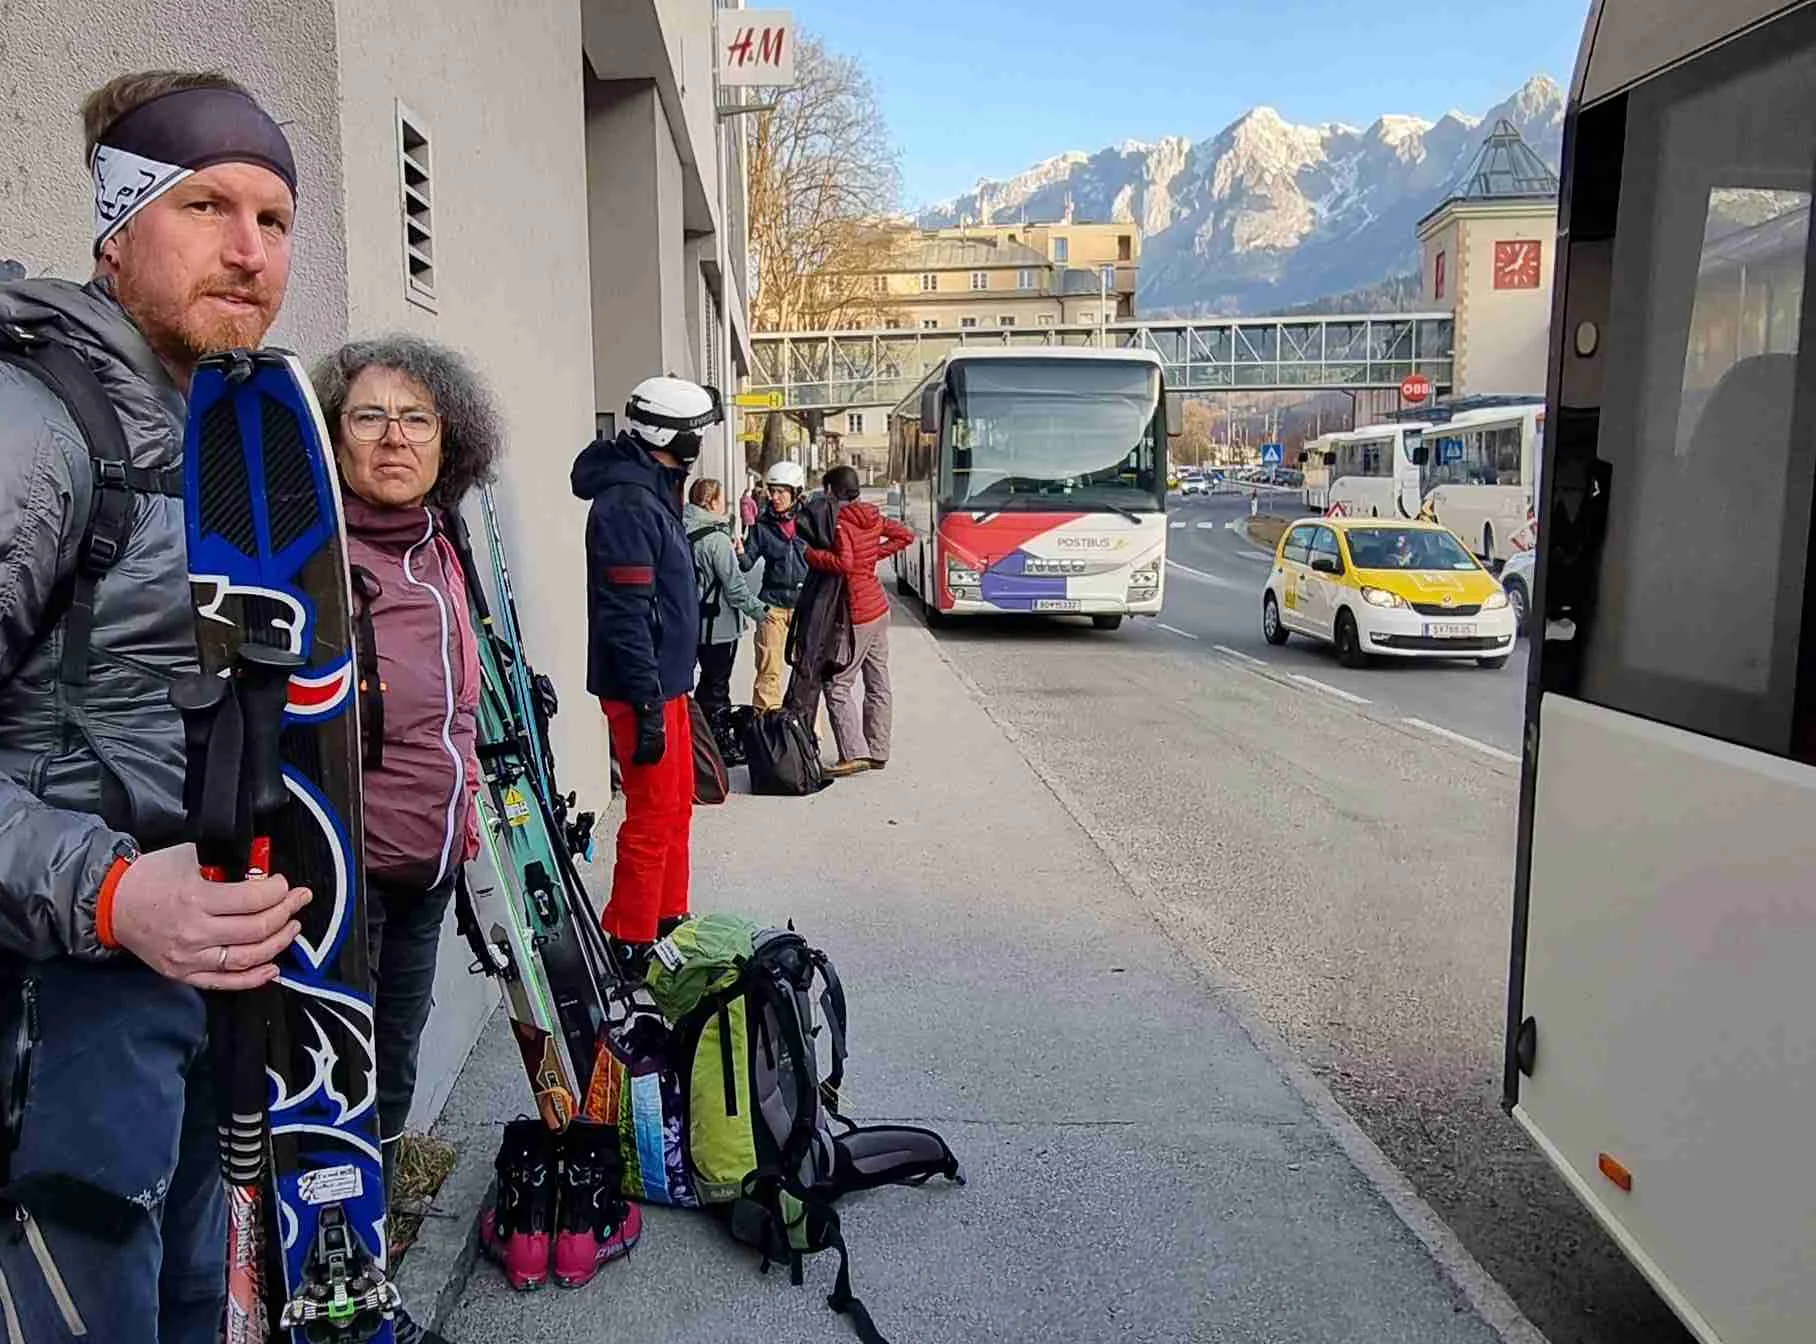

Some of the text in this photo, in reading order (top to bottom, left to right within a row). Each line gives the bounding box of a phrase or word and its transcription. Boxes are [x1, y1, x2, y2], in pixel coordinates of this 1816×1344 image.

[727, 27, 785, 67] H&M
[769, 393, 780, 408] H
[1057, 537, 1110, 549] POSTBUS
[1026, 559, 1085, 573] IVECO
